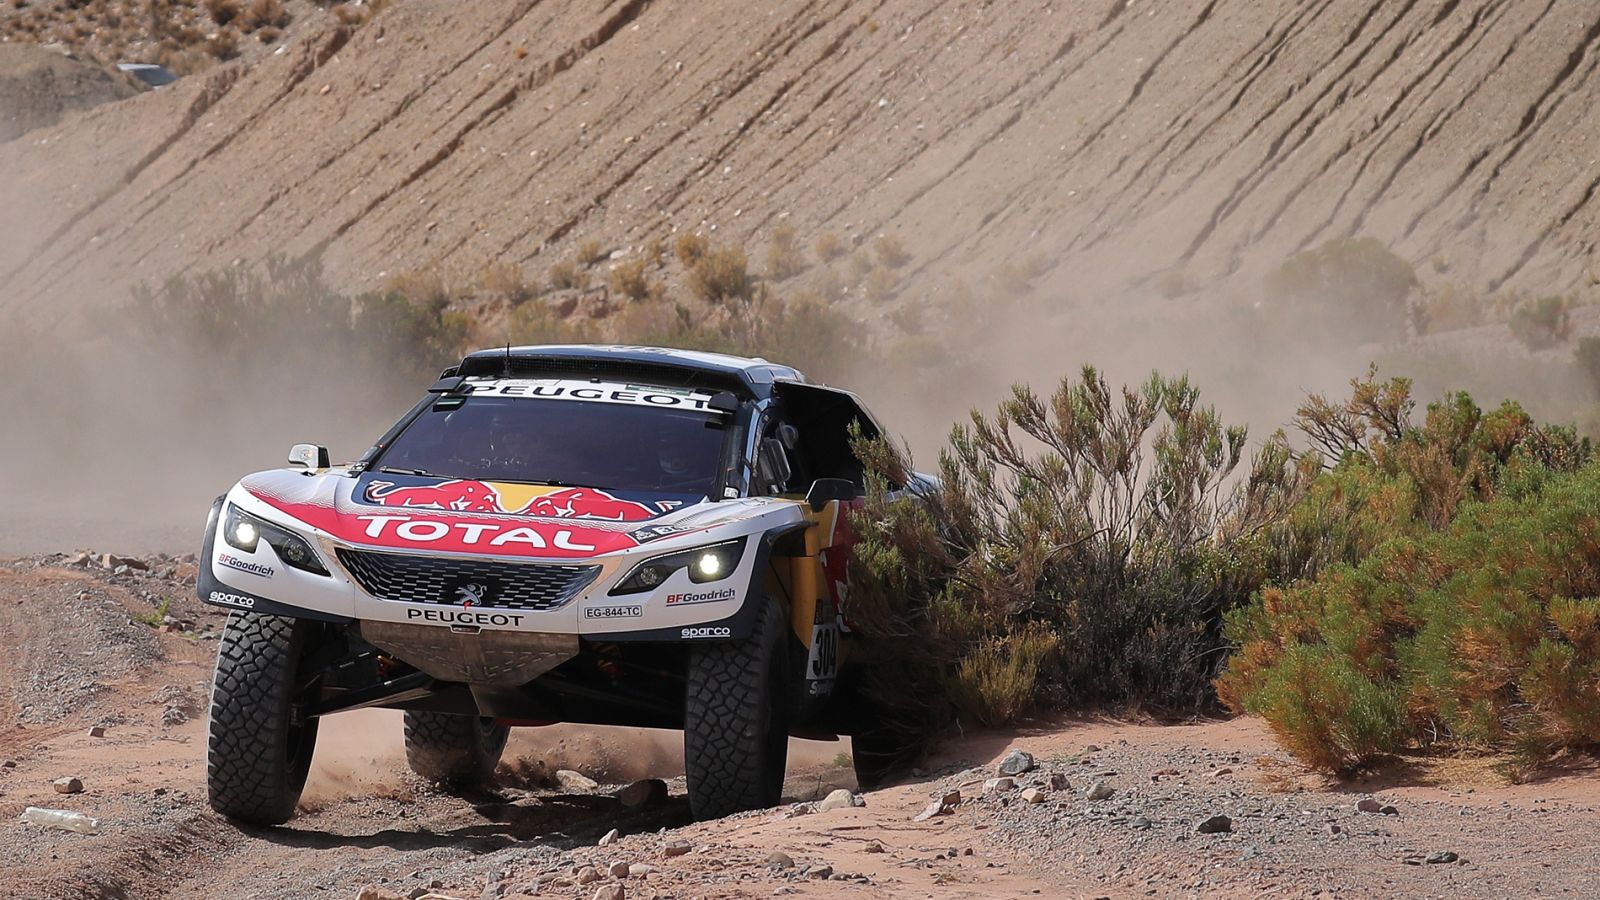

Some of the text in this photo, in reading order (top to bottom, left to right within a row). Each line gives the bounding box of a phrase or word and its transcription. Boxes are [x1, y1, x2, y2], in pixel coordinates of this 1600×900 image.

[465, 386, 709, 409] PEUGEOT
[356, 515, 596, 551] TOTAL
[219, 553, 275, 576] BFGoodrich
[209, 591, 255, 607] sparco
[666, 588, 736, 604] BFGoodrich
[407, 608, 525, 627] PEUGEOT
[586, 607, 640, 618] EG-844-TC
[681, 627, 731, 639] sparco
[812, 628, 837, 677] 304
